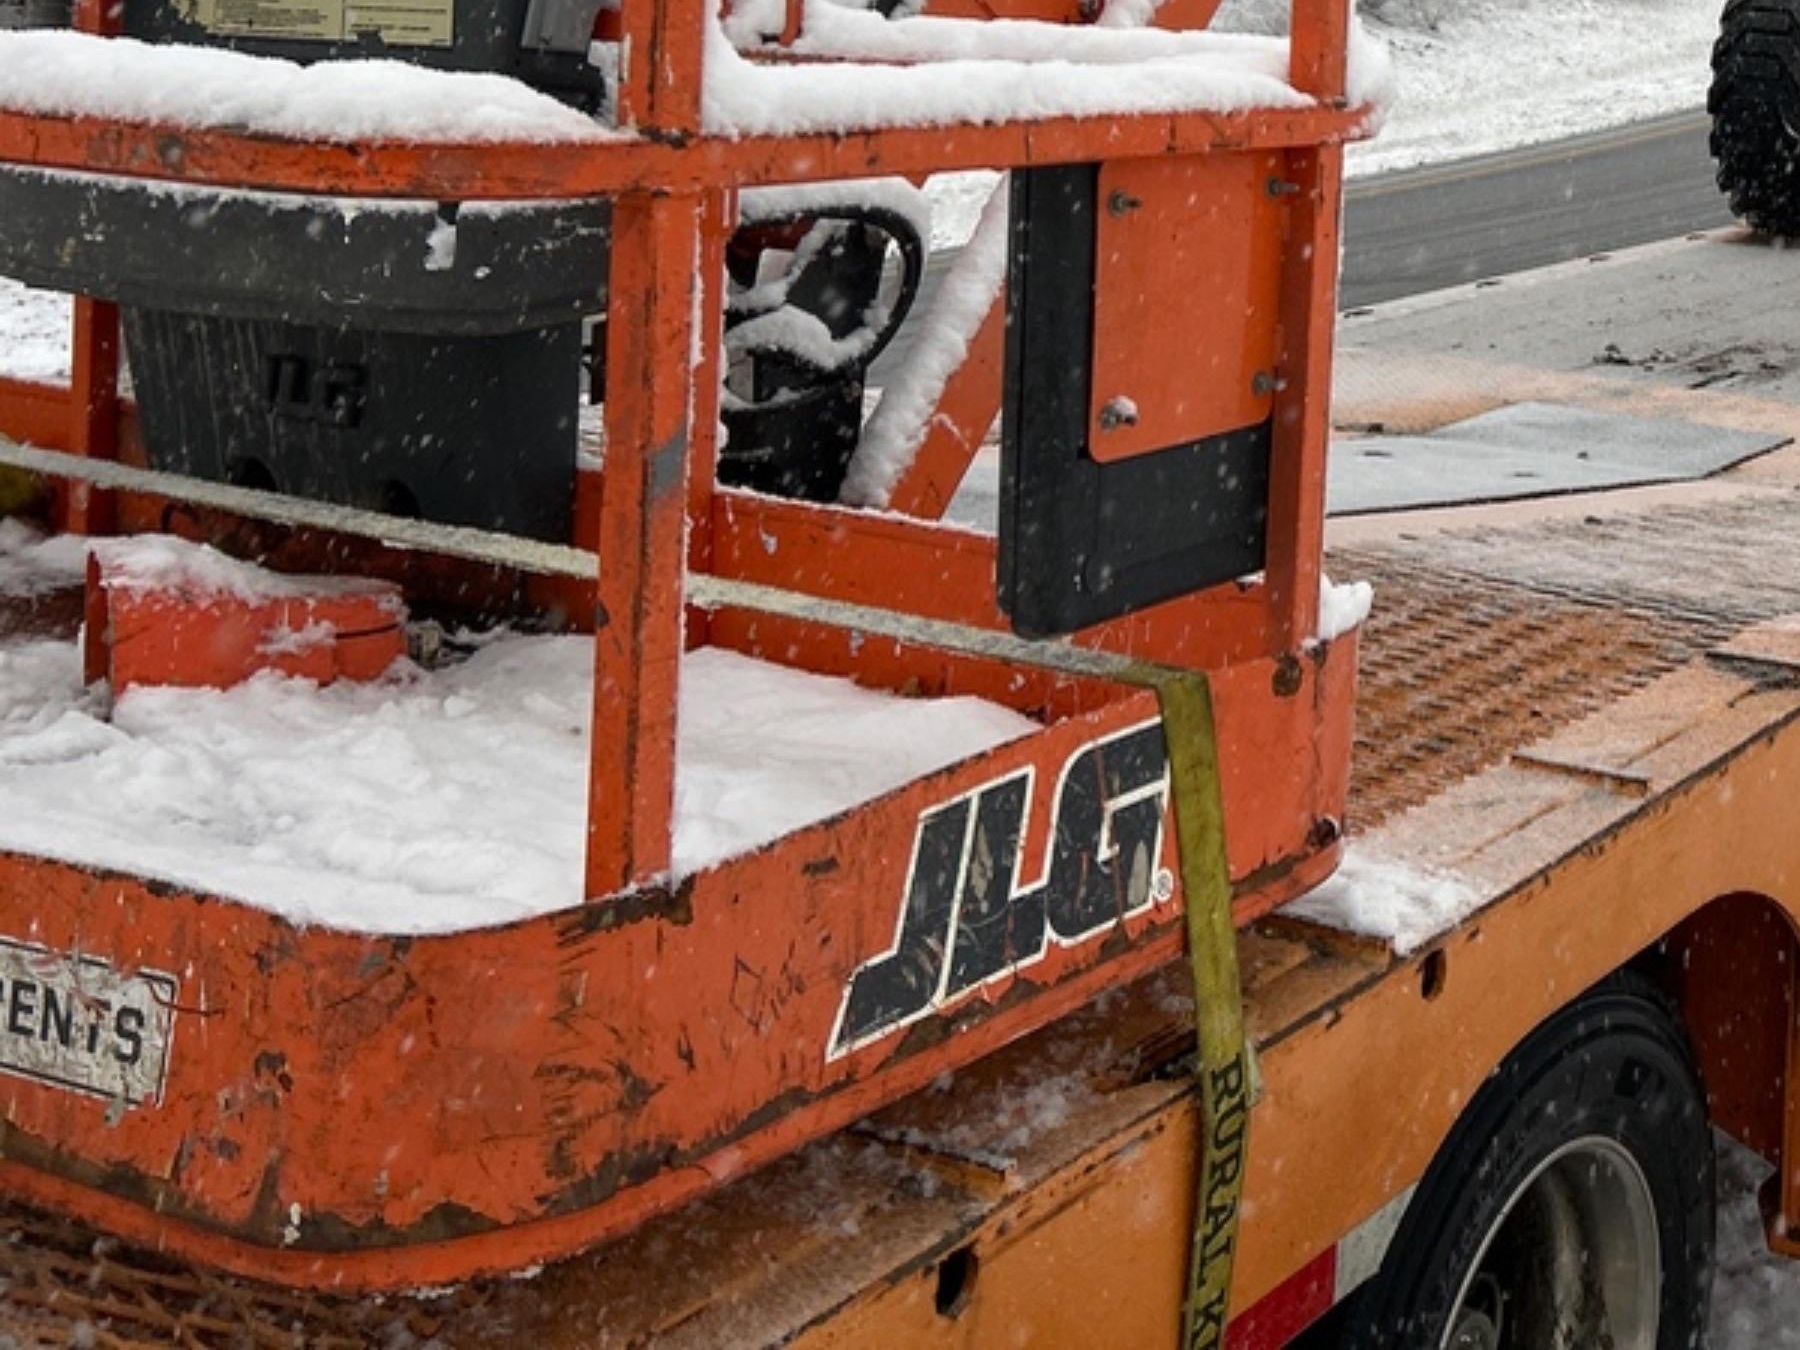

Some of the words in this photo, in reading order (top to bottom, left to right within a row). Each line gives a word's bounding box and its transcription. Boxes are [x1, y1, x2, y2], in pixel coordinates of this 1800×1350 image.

[826, 715, 1170, 1063] JLG
[0, 978, 146, 1066] ENTS
[1197, 1052, 1247, 1290] RURAL
